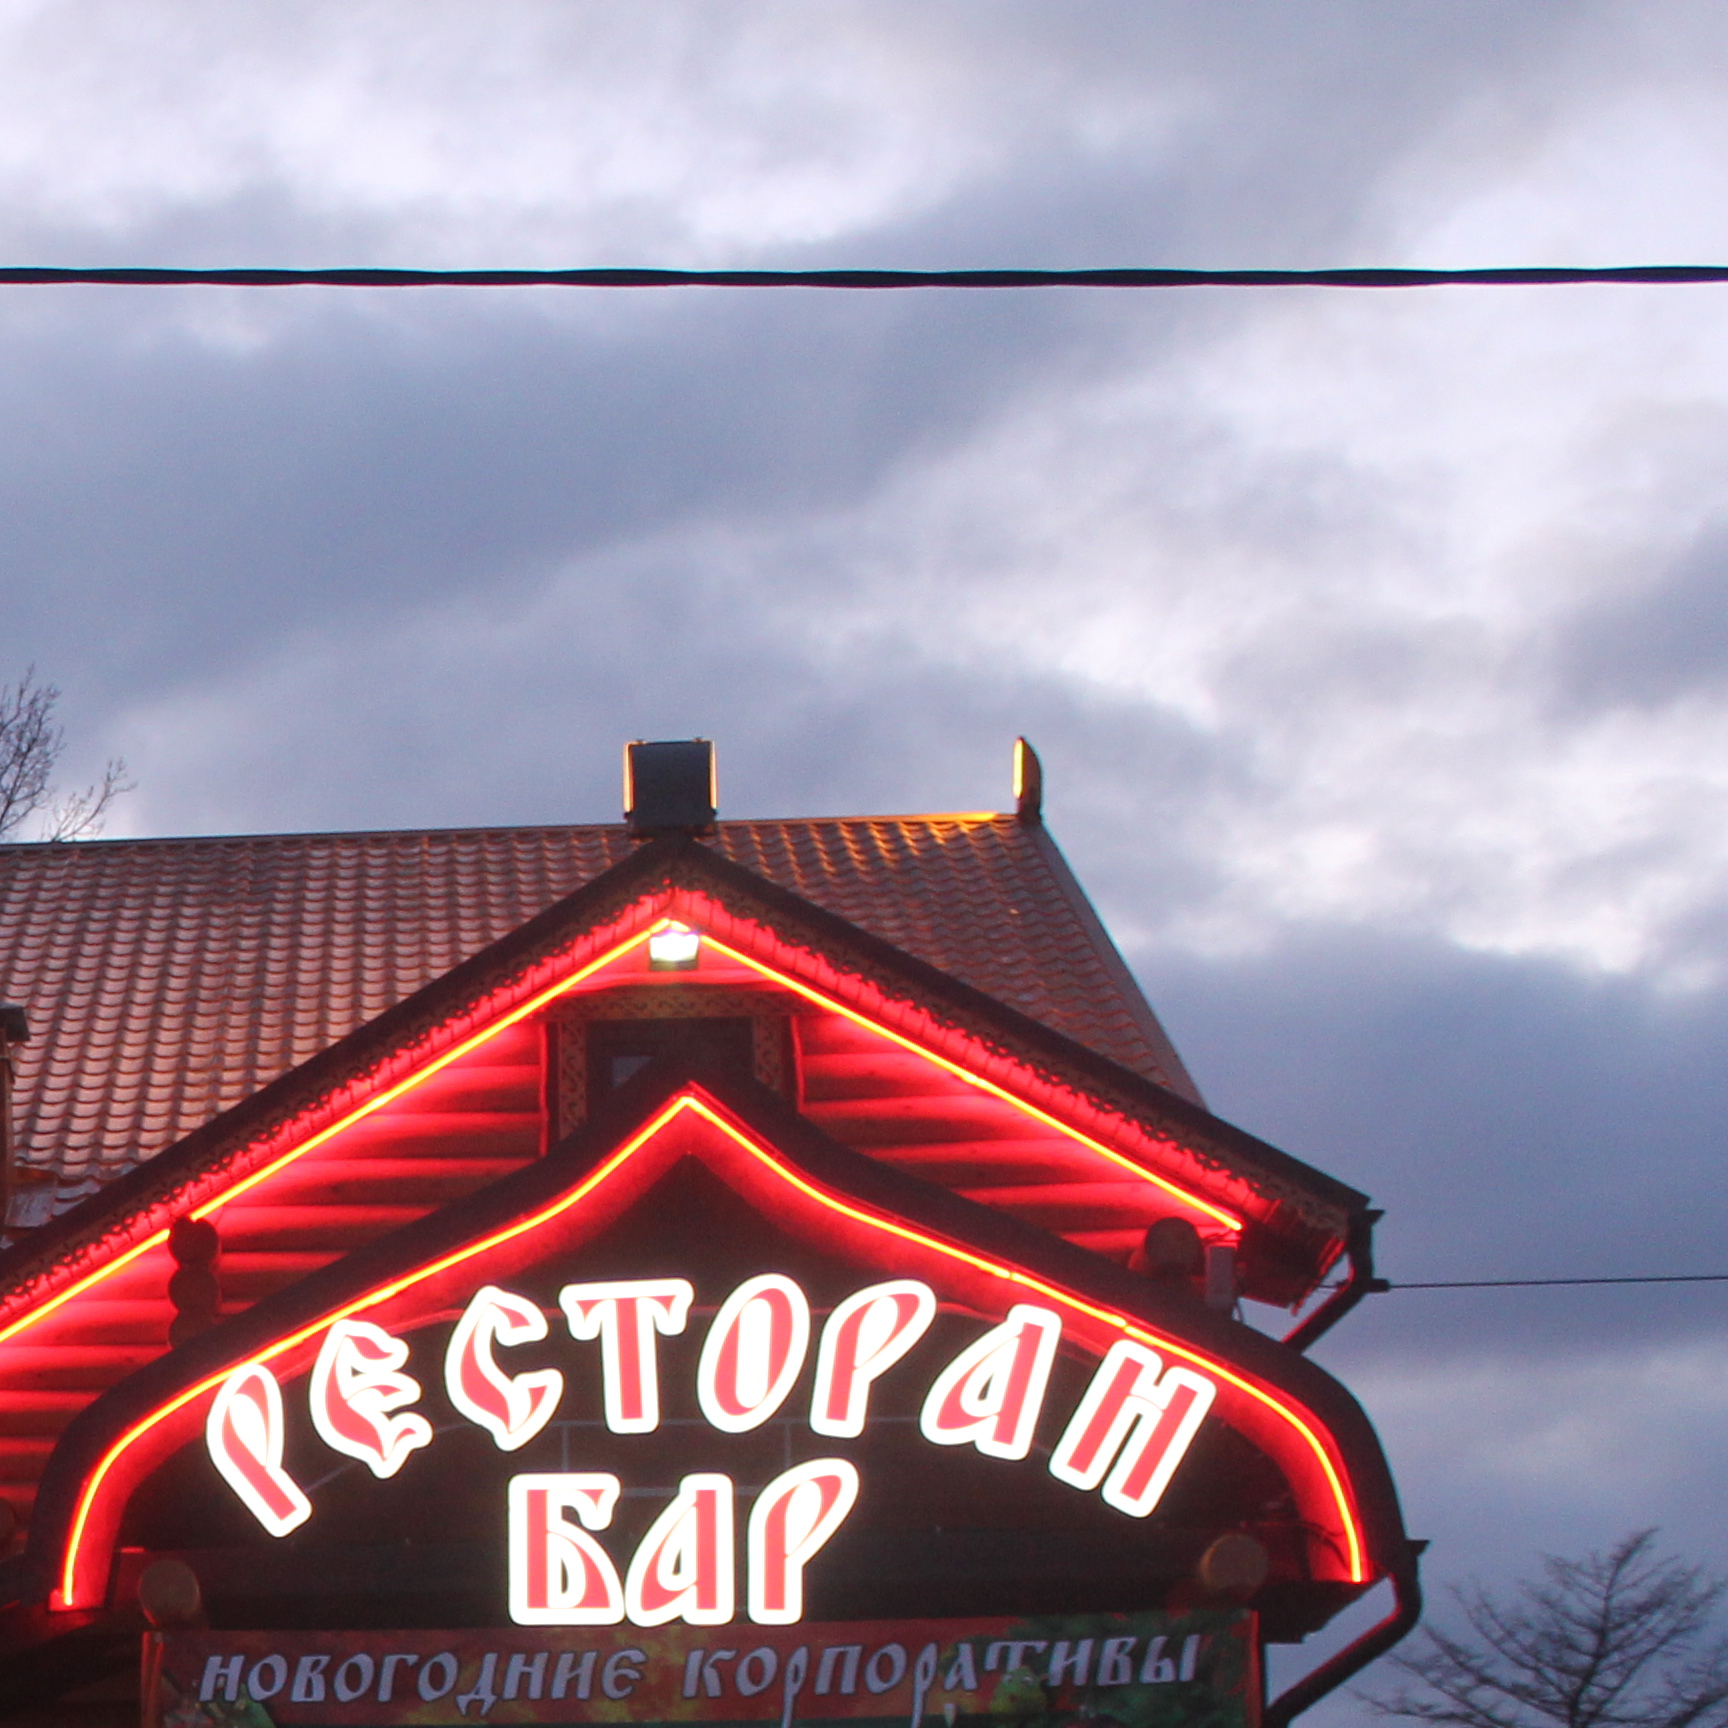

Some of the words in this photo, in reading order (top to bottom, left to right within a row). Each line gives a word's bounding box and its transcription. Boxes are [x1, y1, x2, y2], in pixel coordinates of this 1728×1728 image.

[205, 1273, 1216, 1538] РЕСТОРАН
[508, 1458, 859, 1627] БАР
[199, 1648, 648, 1716] НОВОГОДНИЕ
